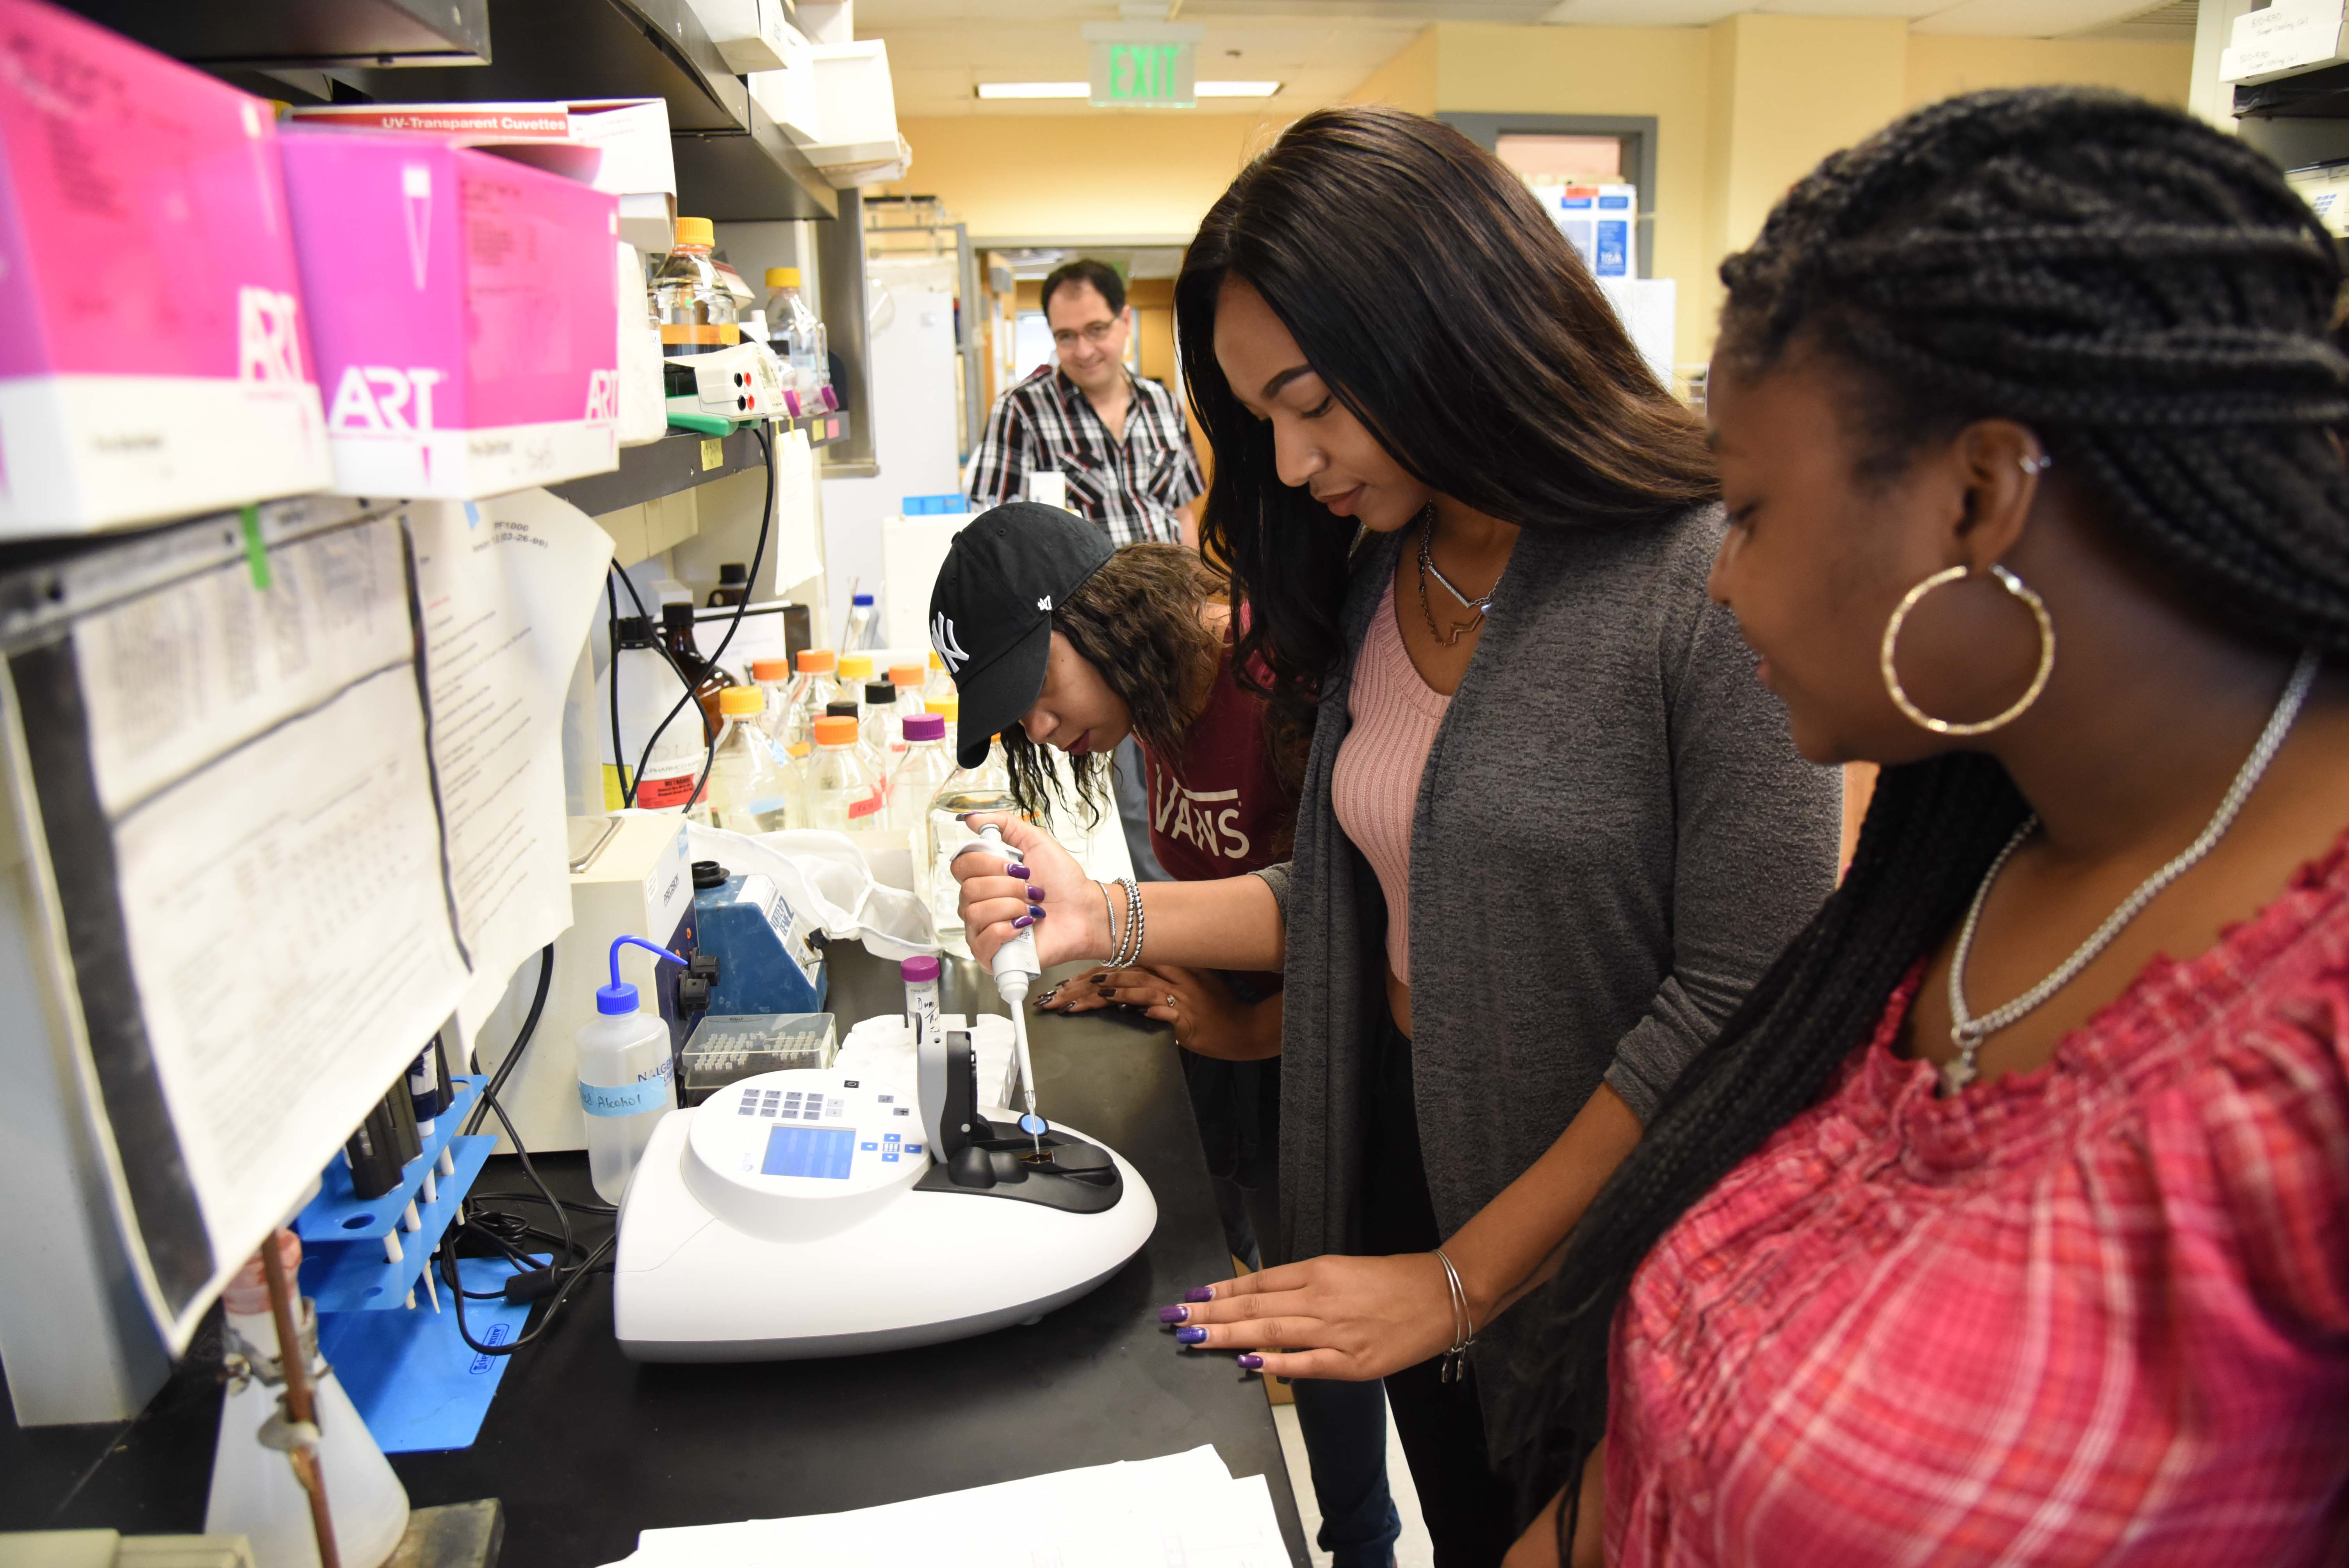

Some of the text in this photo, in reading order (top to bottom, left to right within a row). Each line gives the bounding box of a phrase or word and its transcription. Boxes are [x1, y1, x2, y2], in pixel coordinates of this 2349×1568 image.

[1112, 45, 1179, 98] EXIT
[382, 117, 566, 130] UV-Transparent Cuvettes
[327, 365, 440, 430] ART
[494, 521, 529, 531] PF1000
[1155, 763, 1249, 858] VANS
[597, 1094, 642, 1109] Alcohol
